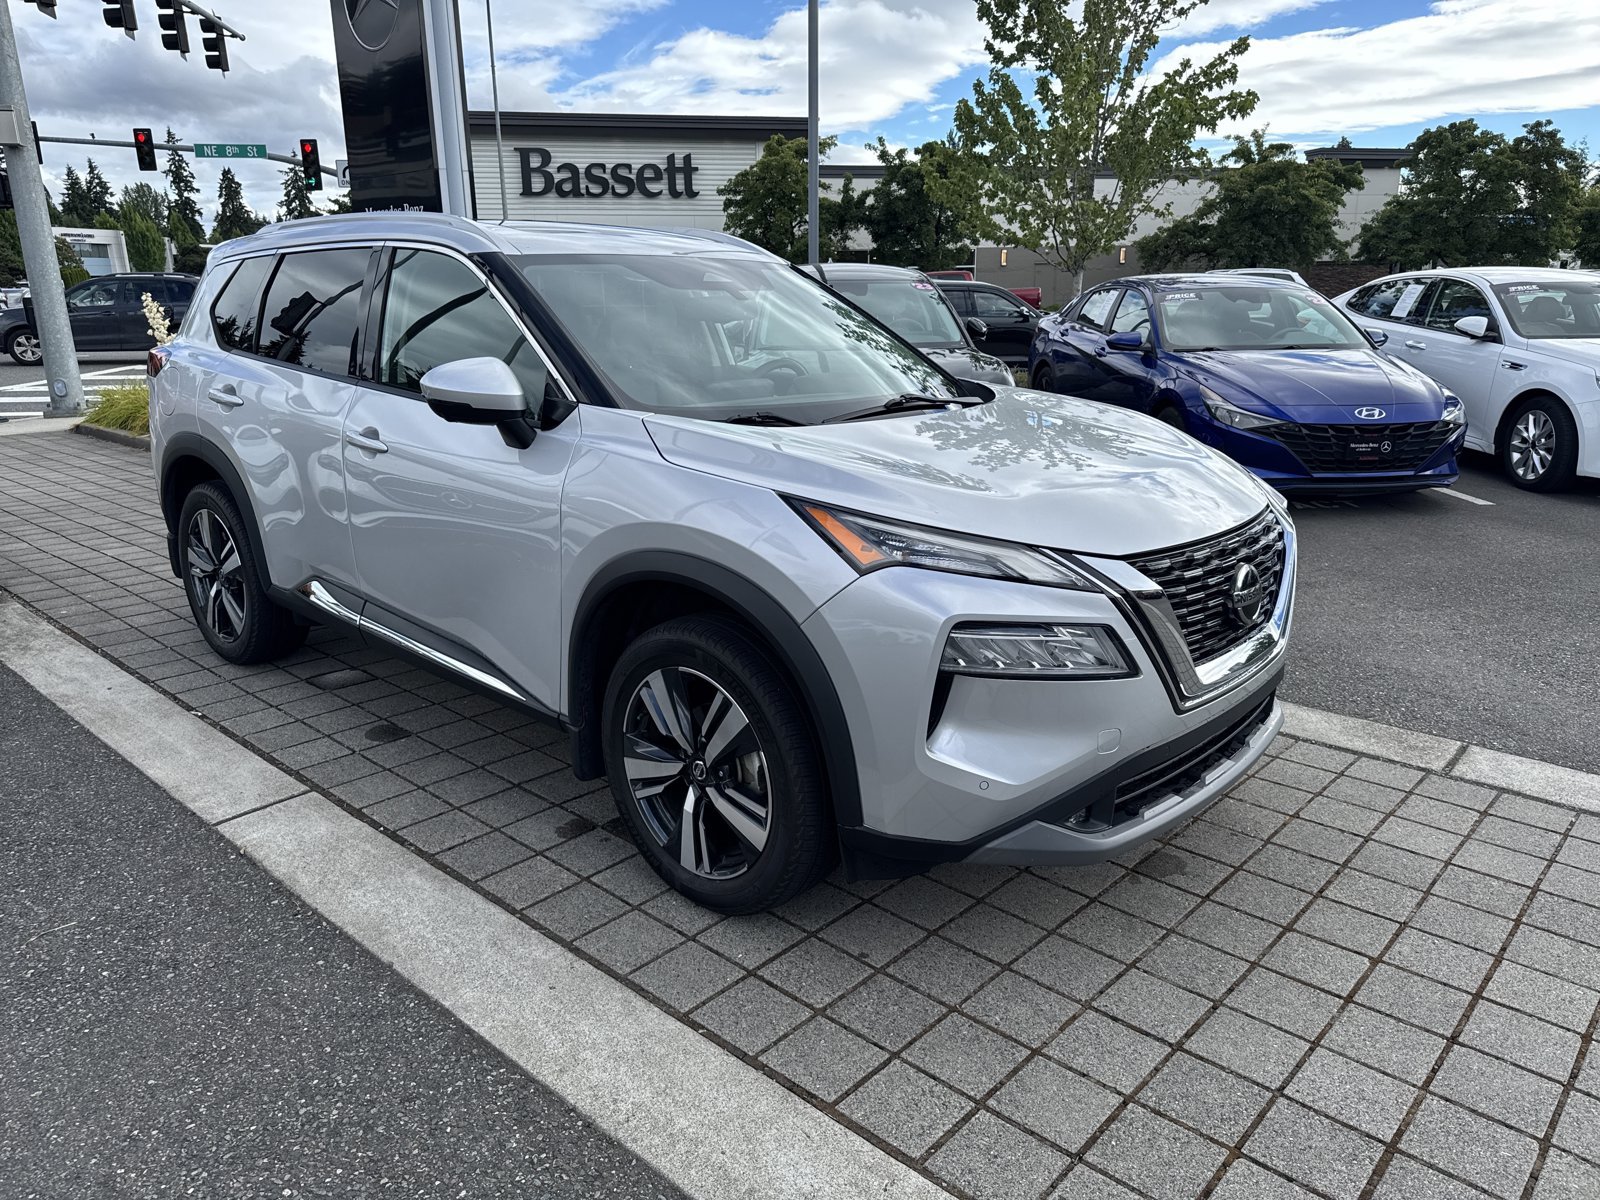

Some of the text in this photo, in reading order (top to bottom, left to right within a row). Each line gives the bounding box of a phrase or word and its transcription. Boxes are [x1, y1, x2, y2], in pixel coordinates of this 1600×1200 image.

[203, 145, 258, 157] NE 8th St
[513, 147, 700, 199] Bassett
